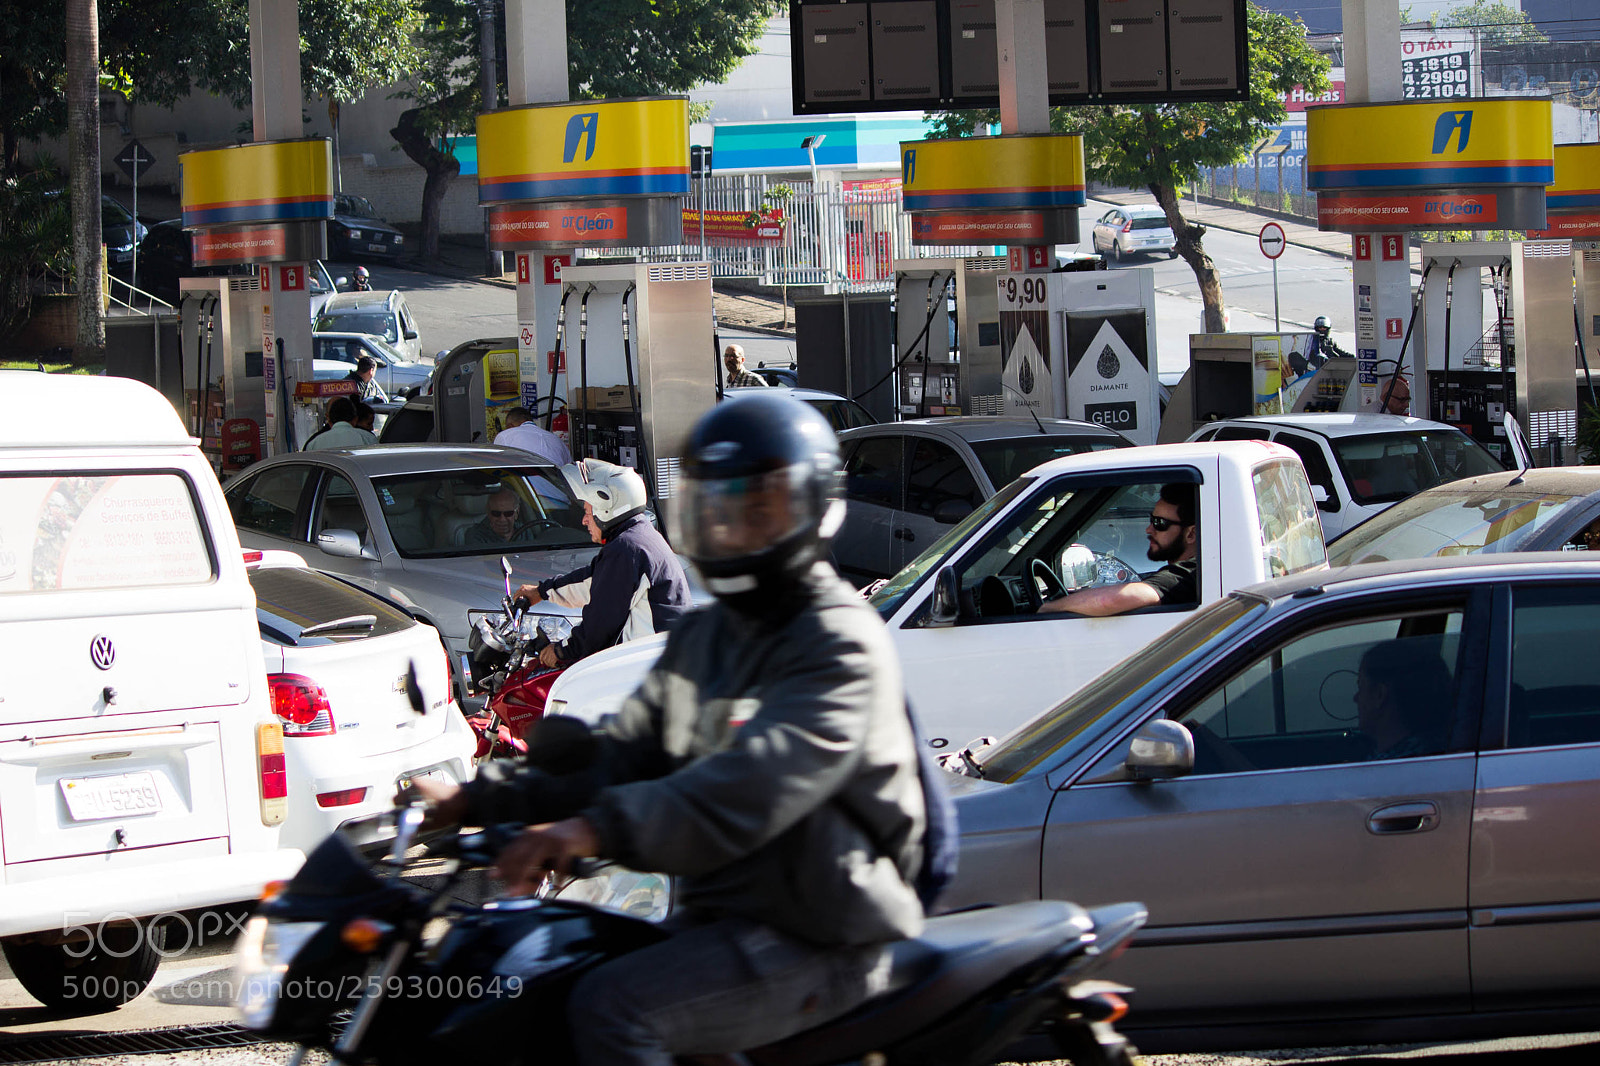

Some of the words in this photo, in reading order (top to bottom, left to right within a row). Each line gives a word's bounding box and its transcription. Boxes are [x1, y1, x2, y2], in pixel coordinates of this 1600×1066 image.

[1418, 37, 1452, 52] TÁXI
[1402, 55, 1463, 74] 3.1819
[1402, 69, 1468, 86] 4.2990
[1291, 89, 1340, 103] Horas
[1402, 83, 1468, 98] 2.2104
[1424, 202, 1439, 213] DT
[1440, 201, 1483, 215] Clean
[561, 216, 574, 228] DT
[575, 215, 614, 231] Clean
[998, 279, 1006, 288] R$
[1006, 277, 1046, 309] 9,90
[322, 382, 354, 393] PIPOCA
[1090, 383, 1129, 392] DIAMANTE
[1015, 400, 1040, 408] DIAMANTE
[1091, 409, 1130, 425] GELO
[103, 497, 174, 511] Churrasqueiro
[101, 512, 145, 524] Serviços
[147, 511, 160, 521] de
[161, 510, 192, 521] Buffet
[510, 712, 533, 721] HONDA
